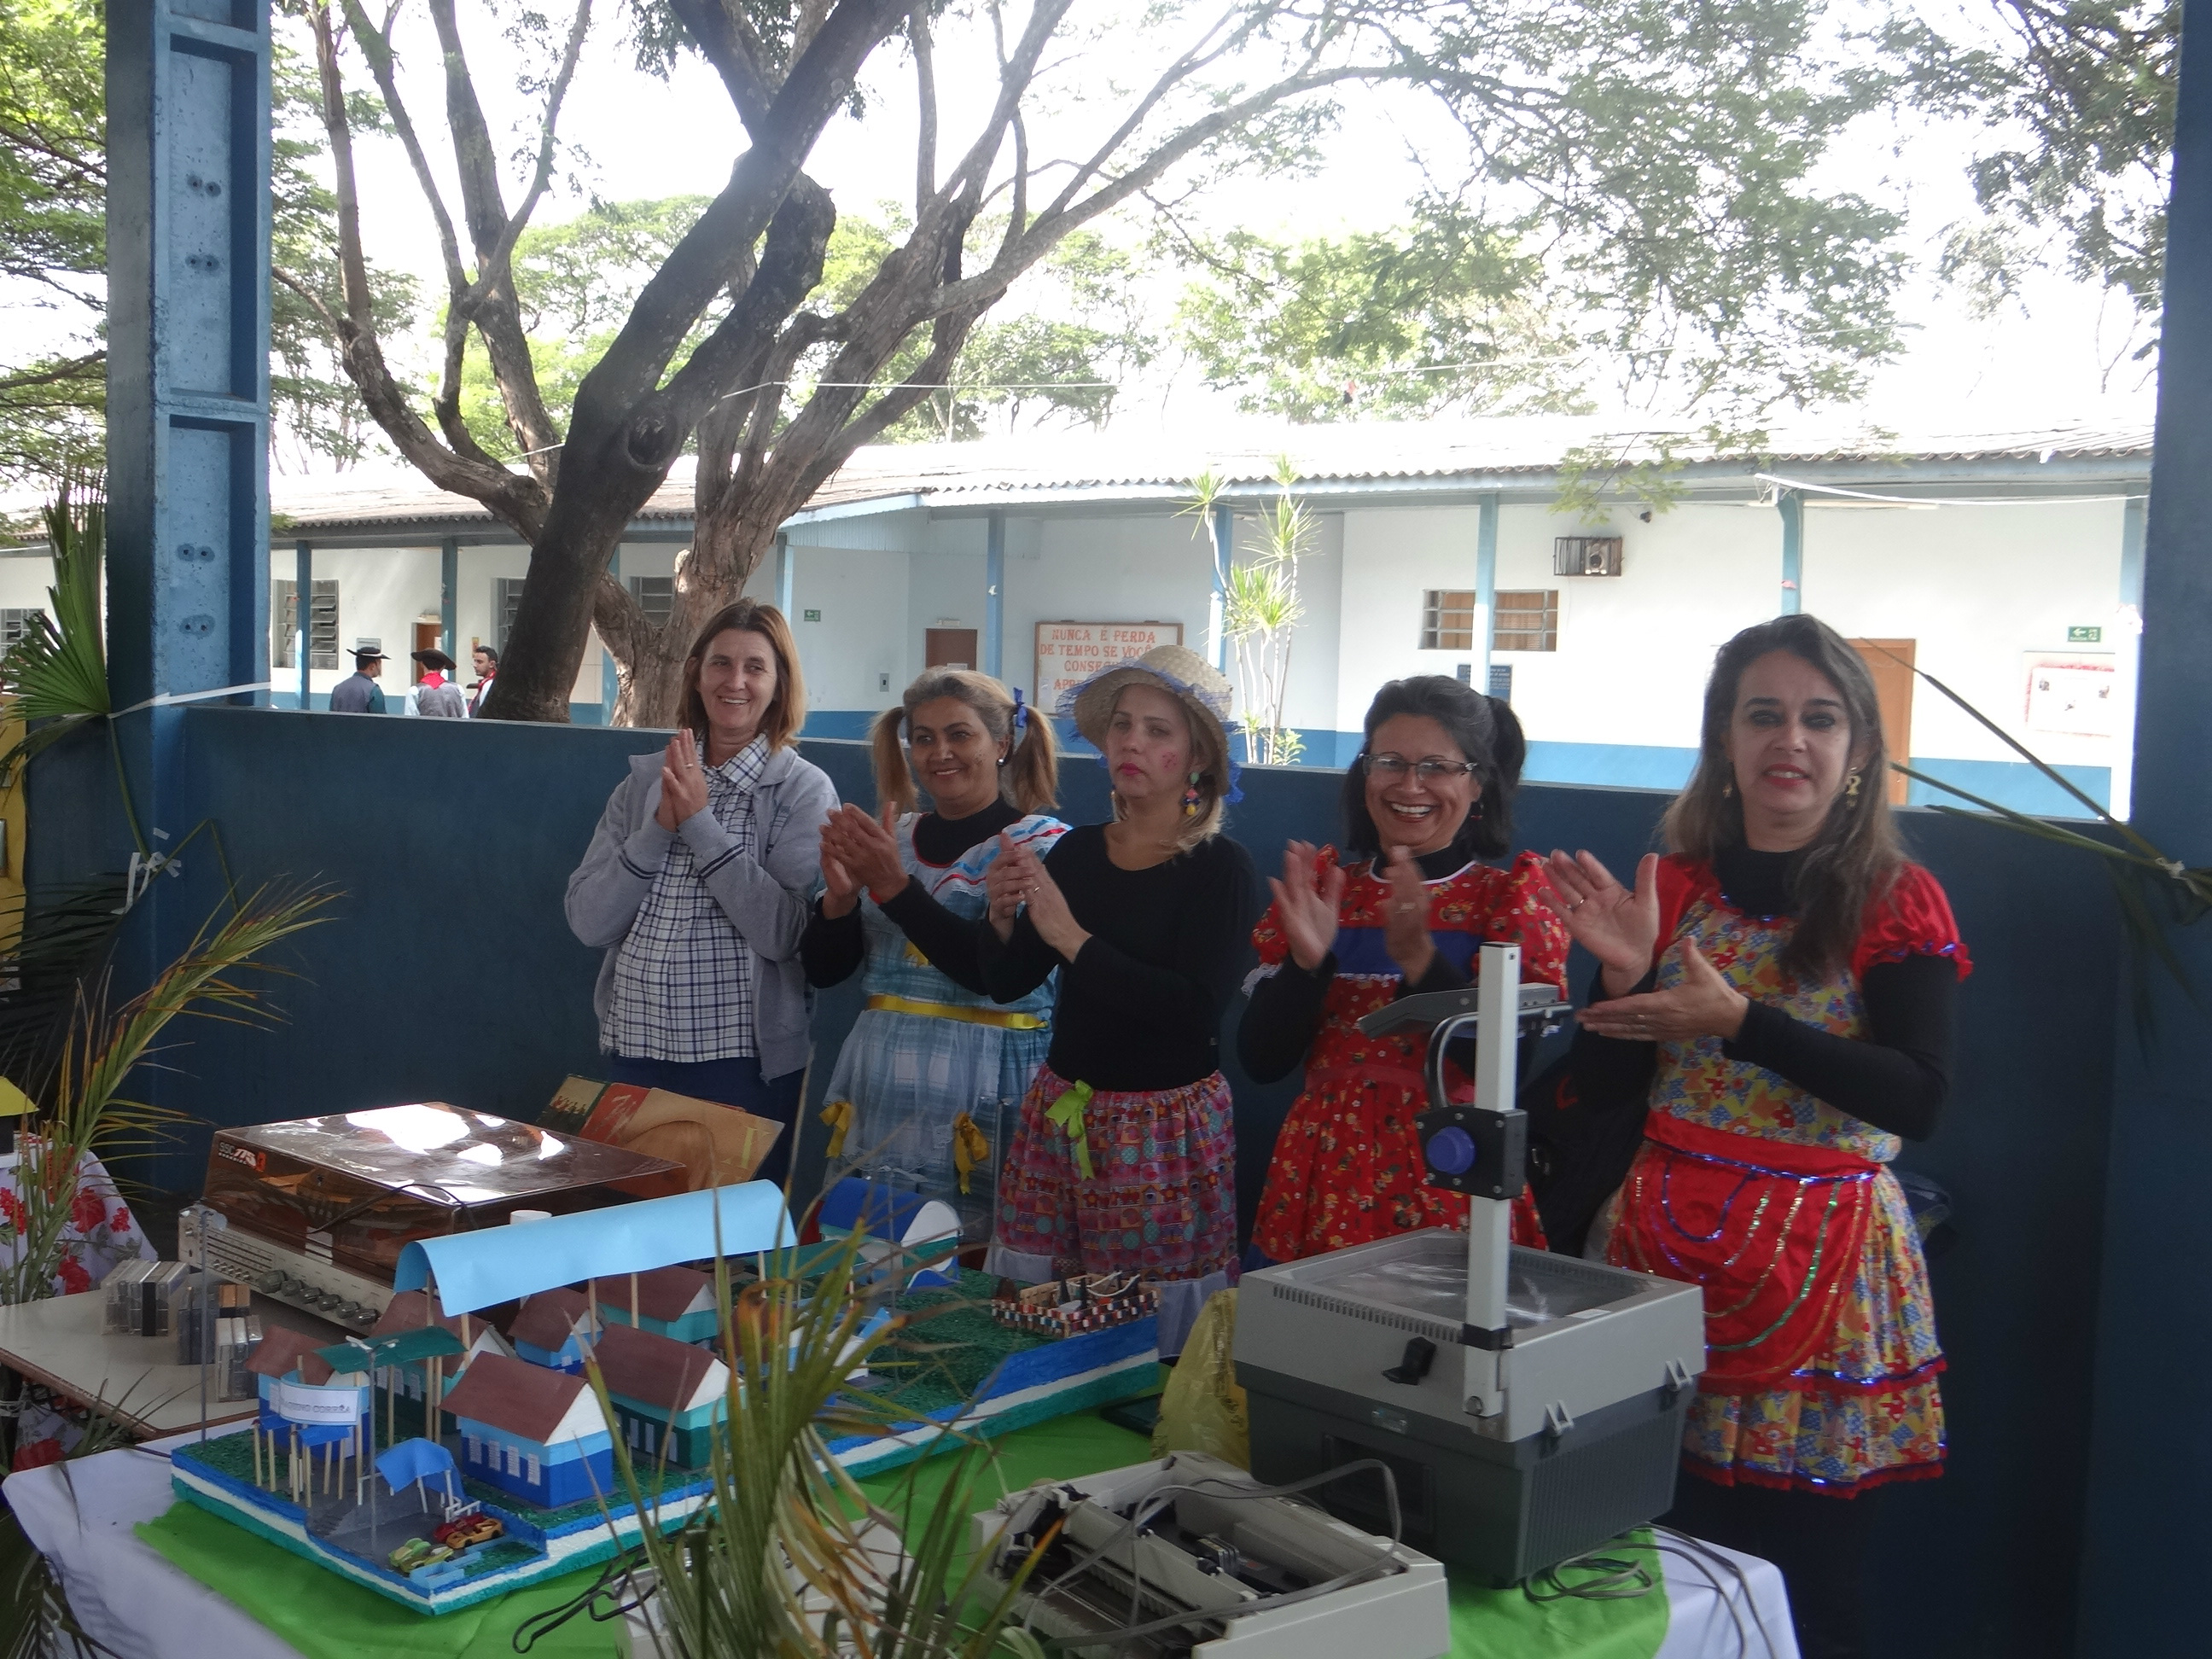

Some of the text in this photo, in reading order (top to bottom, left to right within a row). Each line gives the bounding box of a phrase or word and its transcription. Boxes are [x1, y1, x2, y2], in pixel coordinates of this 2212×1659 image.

[1051, 626, 1155, 643] NUNCA É PERDA
[1039, 643, 1055, 655] DE
[1059, 644, 1099, 657] TEMPO
[1103, 646, 1118, 658] SE
